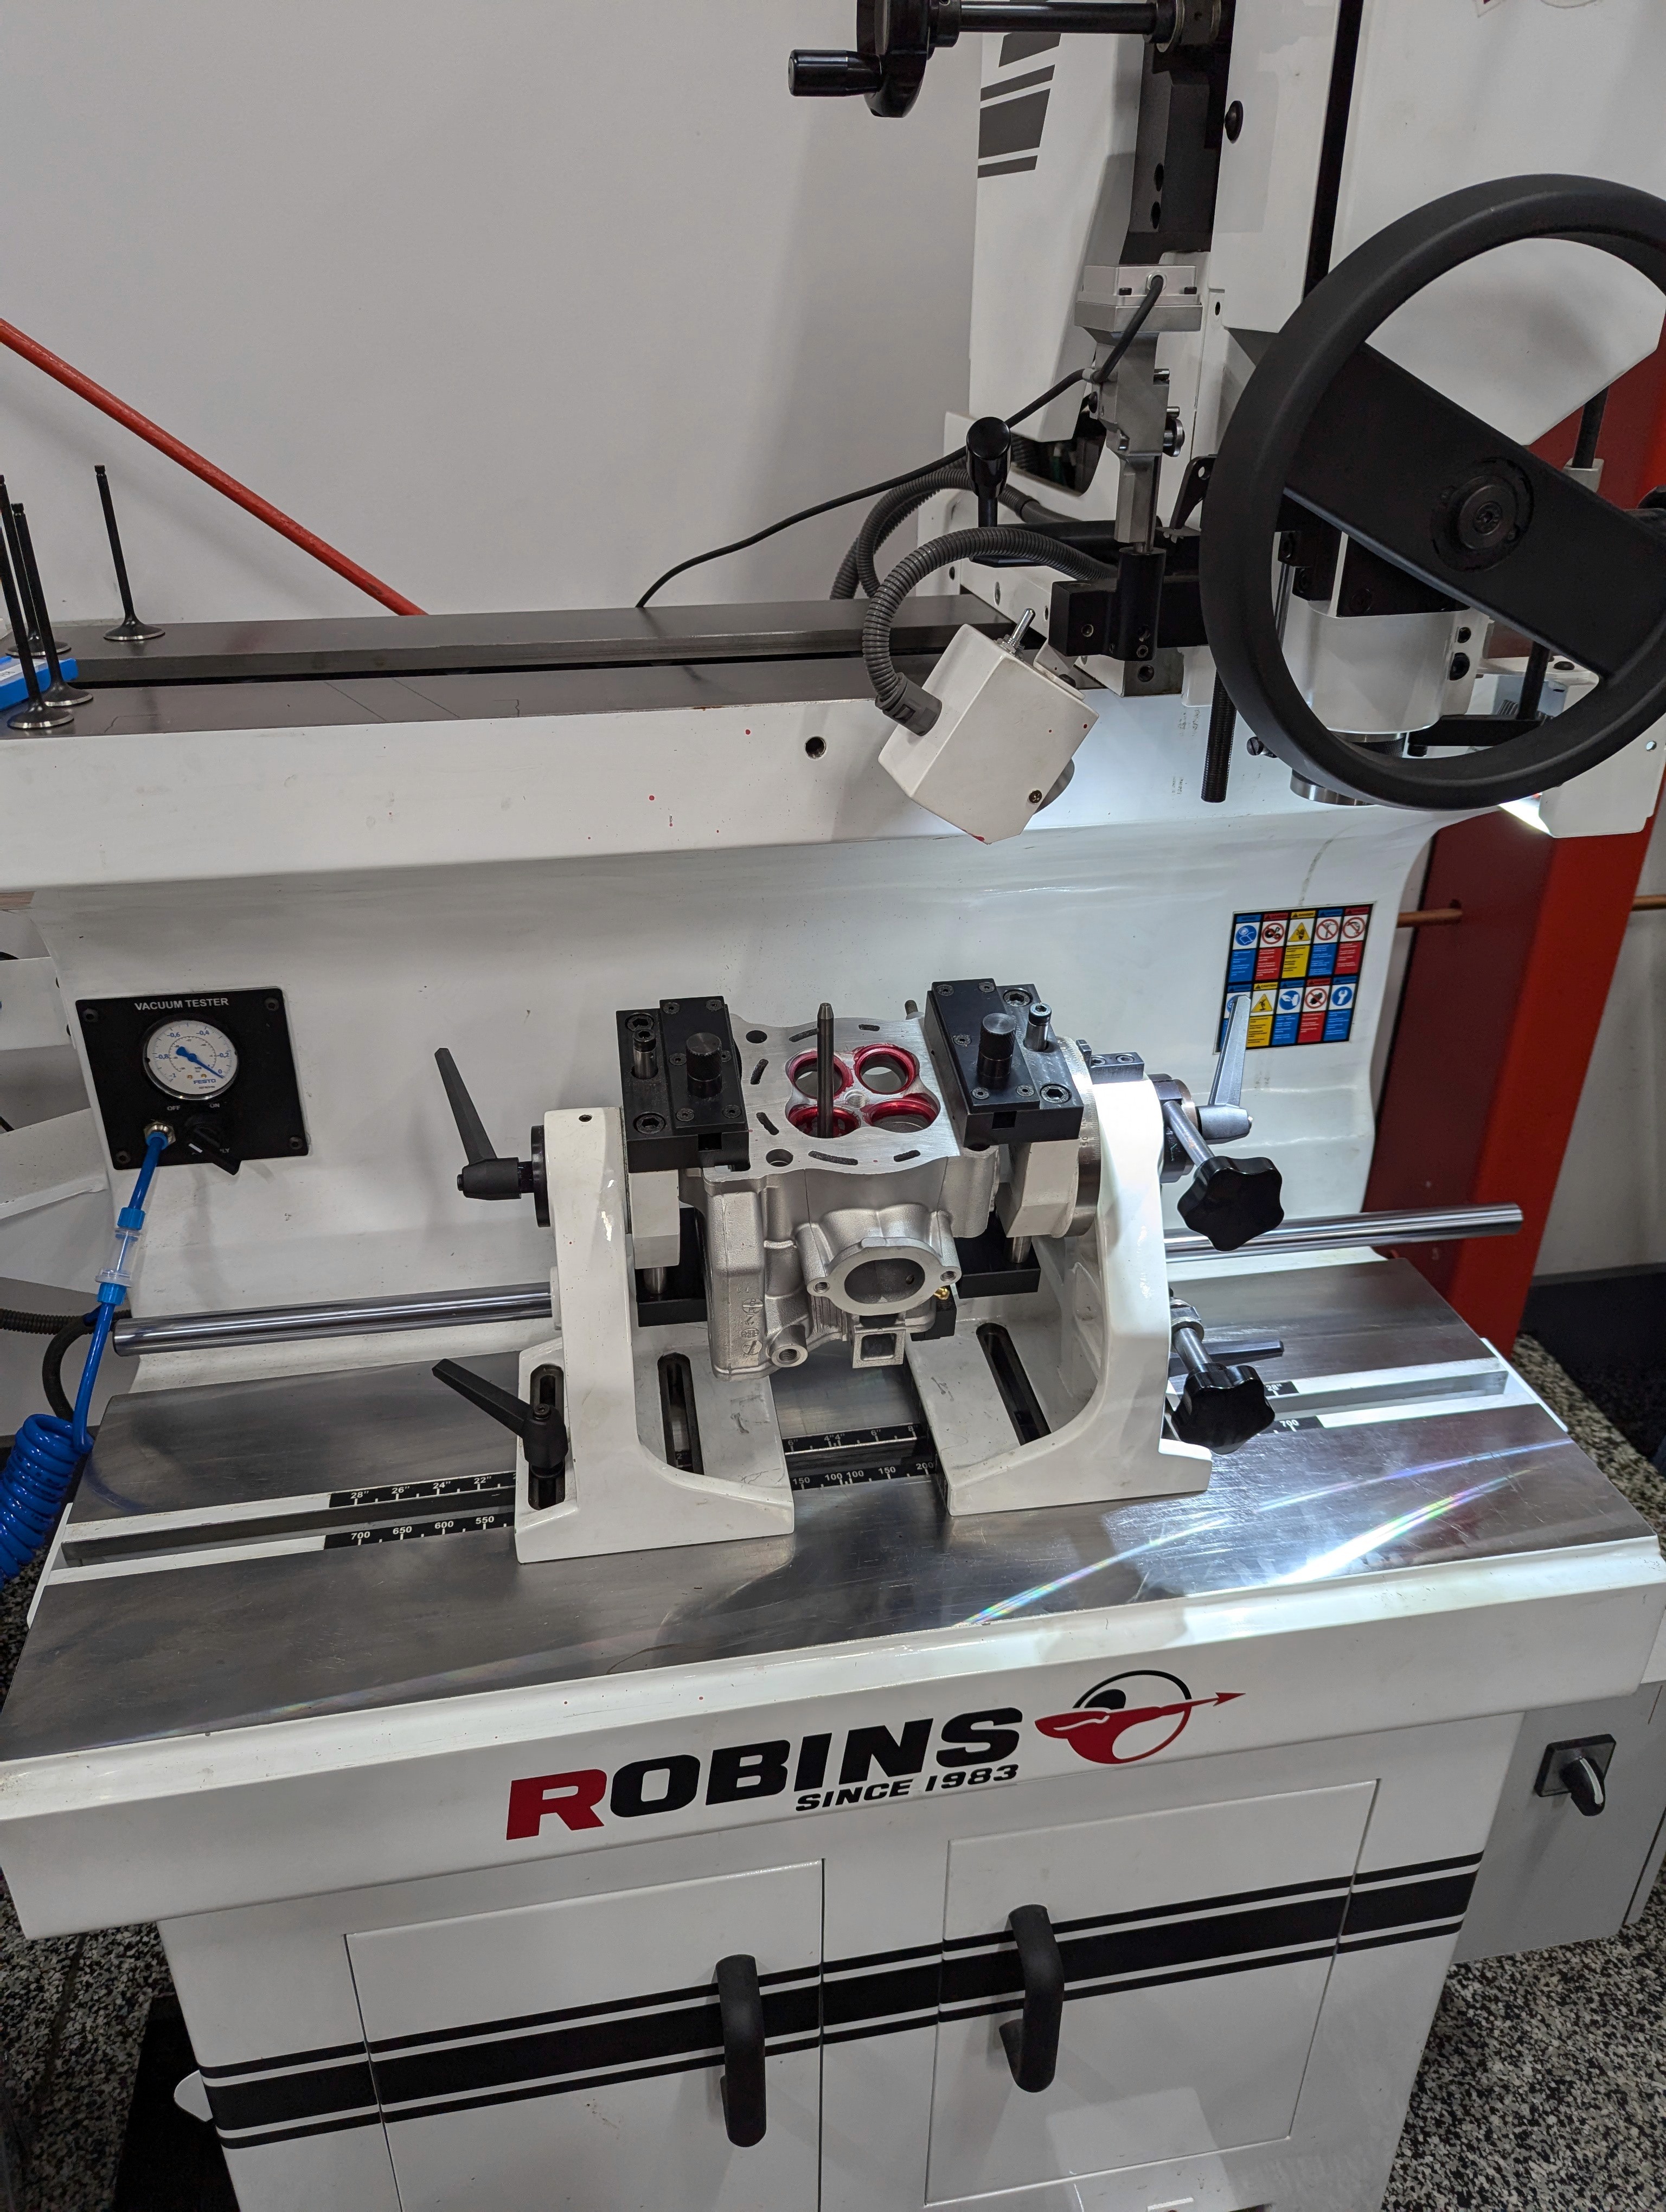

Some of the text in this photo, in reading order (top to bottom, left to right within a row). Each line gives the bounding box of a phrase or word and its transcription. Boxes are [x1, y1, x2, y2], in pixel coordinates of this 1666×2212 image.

[134, 998, 229, 1011] VACUUM TESTER
[1082, 1136, 1089, 1146] 50
[1279, 1419, 1300, 1428] 700
[792, 1462, 934, 1485] 150 100 100 150 200
[350, 1476, 492, 1500] 28" 26" 24" 22"
[350, 1516, 495, 1540] 700 650 600 550
[505, 1707, 1023, 1841] ROBINS
[795, 1764, 1019, 1811] SINCE 1983
